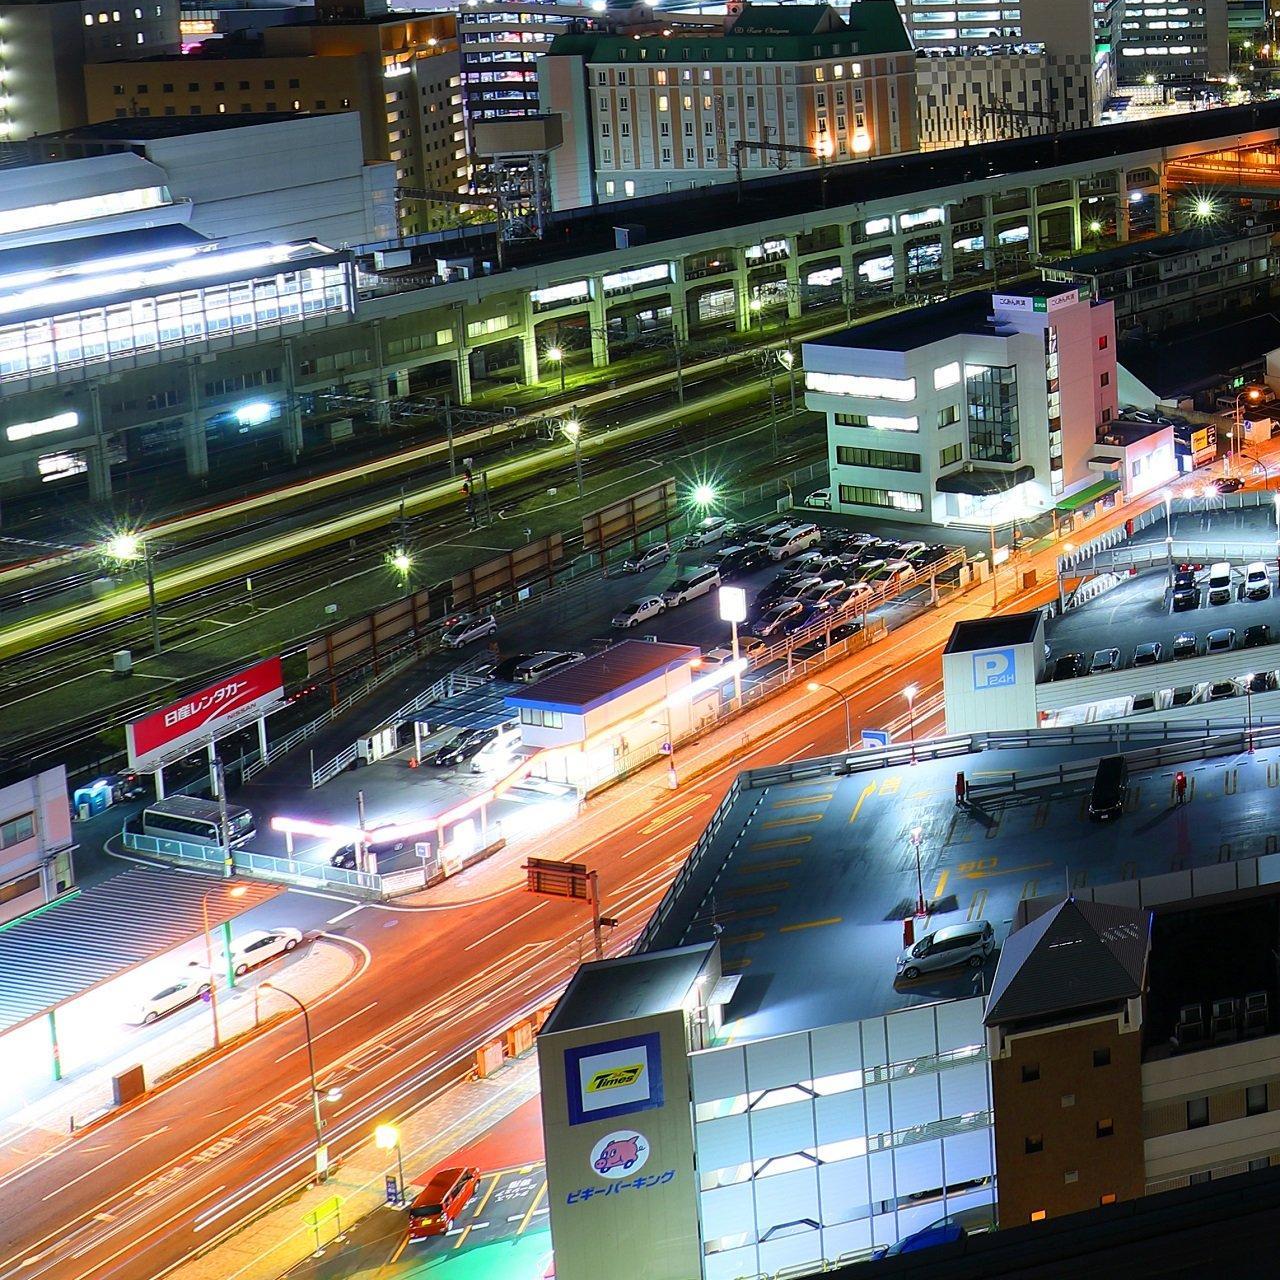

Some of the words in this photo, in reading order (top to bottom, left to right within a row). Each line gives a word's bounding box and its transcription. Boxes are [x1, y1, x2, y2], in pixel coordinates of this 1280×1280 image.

[974, 653, 1009, 688] P
[988, 674, 1015, 685] 24H
[164, 681, 247, 727] 日産レンタカー
[226, 702, 257, 721] NISSAN
[594, 1067, 640, 1090] Times
